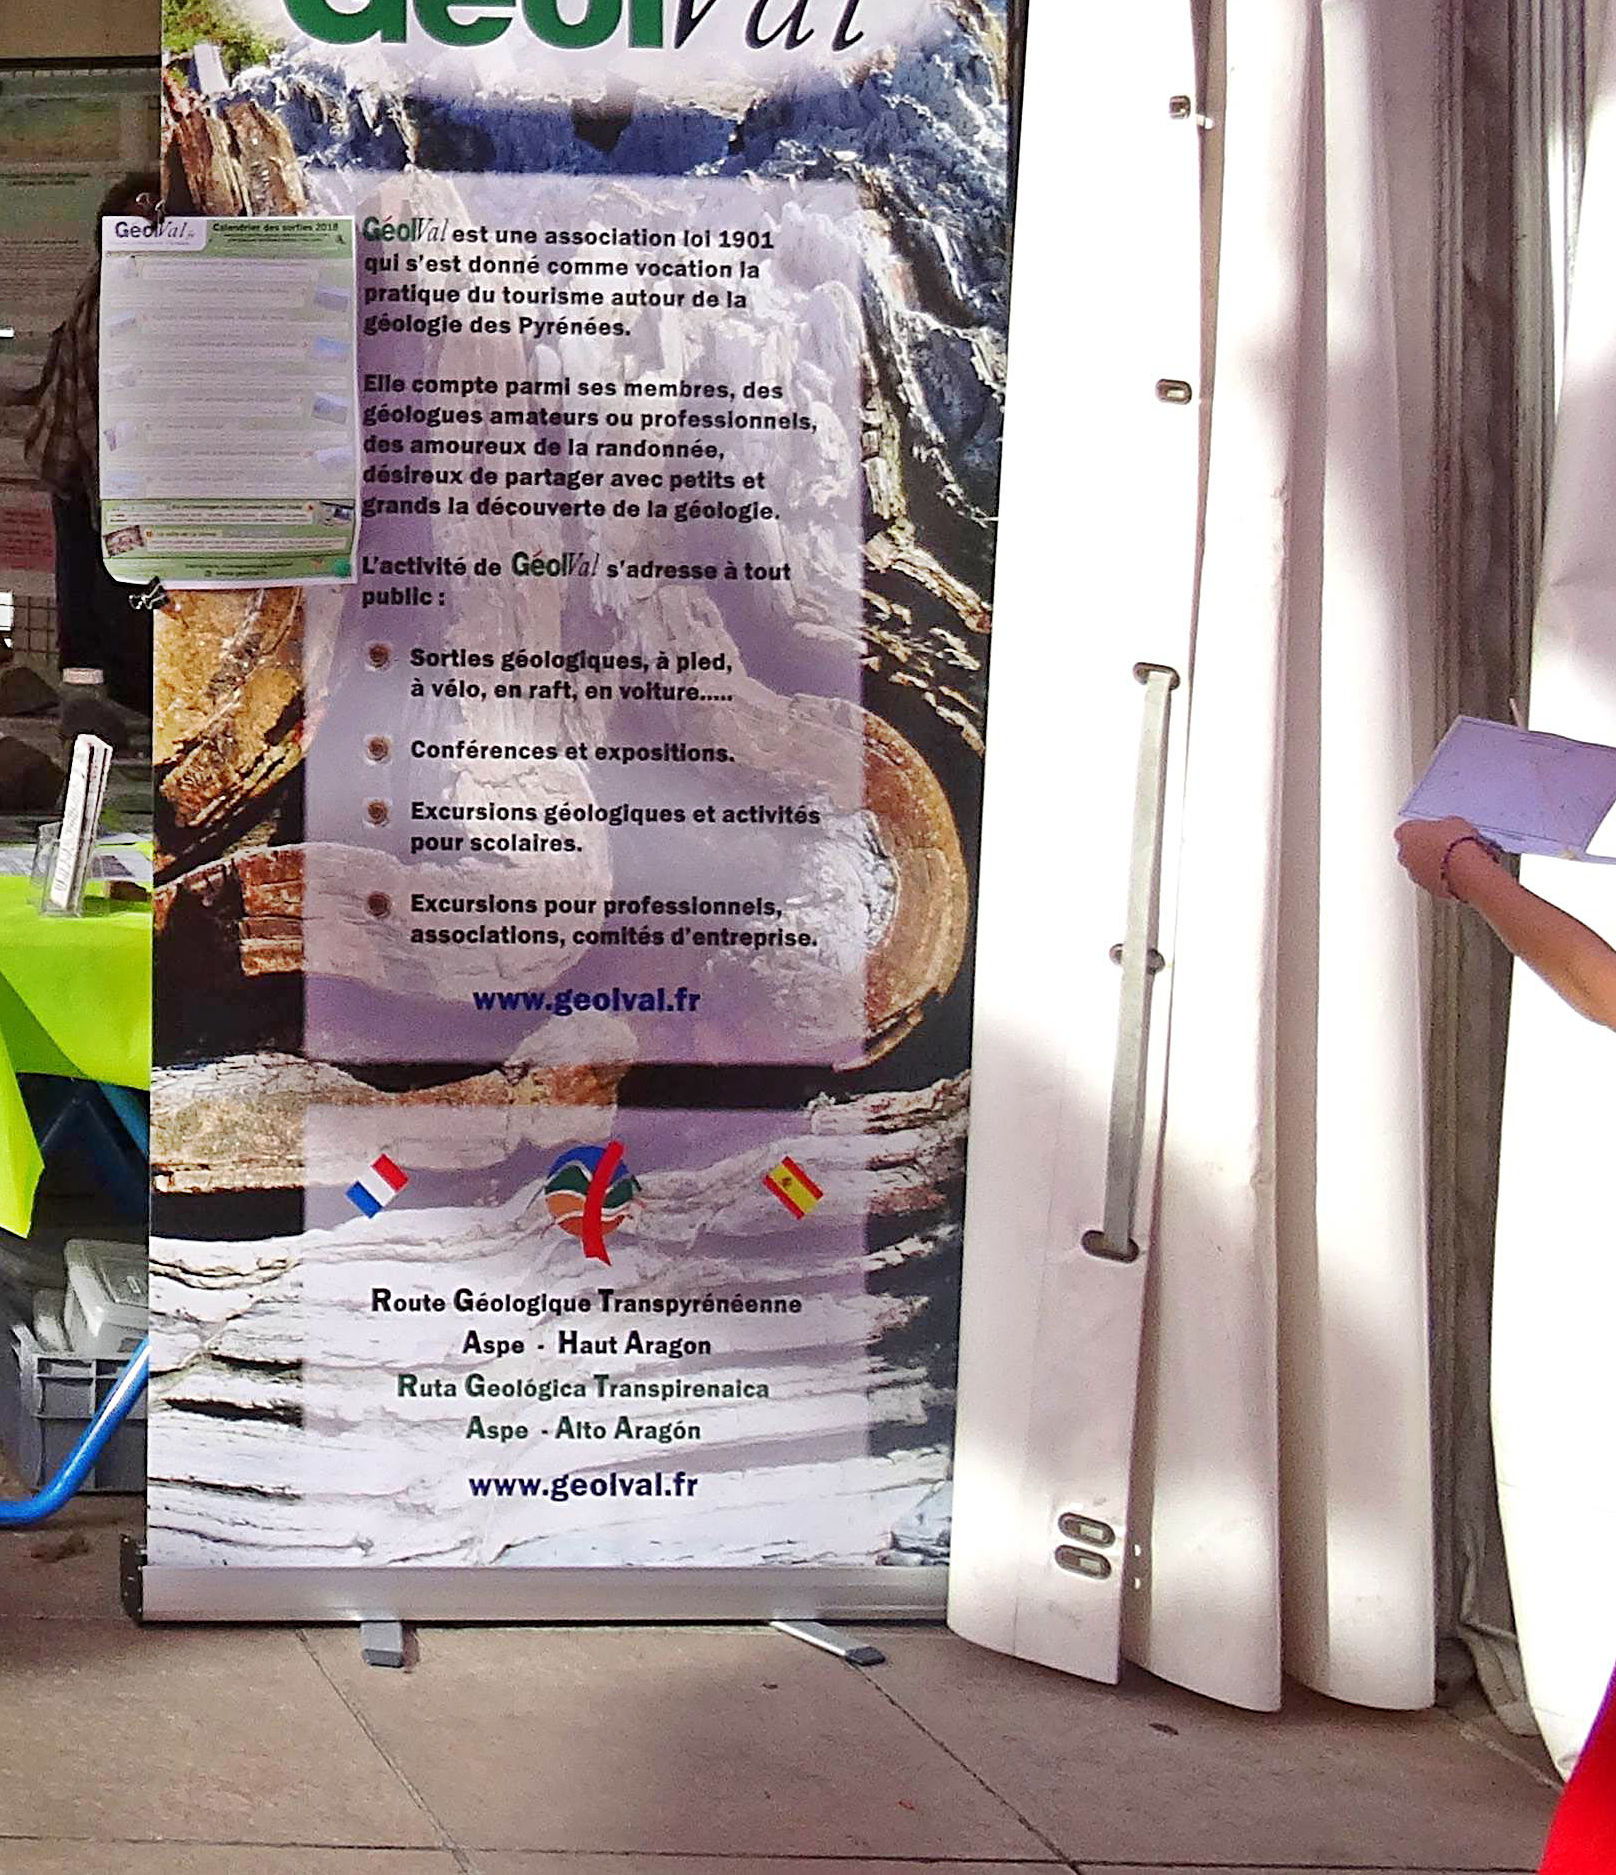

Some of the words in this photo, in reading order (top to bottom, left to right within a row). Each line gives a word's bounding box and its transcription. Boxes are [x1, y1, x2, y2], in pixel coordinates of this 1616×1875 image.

[363, 216, 446, 242] GéolVal
[453, 226, 488, 243] est
[496, 229, 537, 244] une
[545, 228, 676, 247] association
[683, 229, 714, 248] loi
[719, 231, 774, 249] 1901
[366, 255, 399, 276] qui
[407, 256, 461, 274] s'est
[468, 255, 539, 275] donné
[547, 260, 628, 277] comme
[636, 260, 732, 278] vocation
[740, 261, 759, 279] la
[366, 285, 459, 307] pratique
[468, 286, 495, 305] du
[503, 287, 603, 306] tourisme
[611, 289, 685, 307] autour
[692, 291, 719, 308] de
[727, 291, 746, 309] la
[365, 313, 462, 336] géologie
[470, 316, 510, 334] des
[519, 316, 630, 338] Pyrénées.
[365, 375, 405, 394] Elle
[412, 378, 497, 397] compte
[506, 378, 570, 398] parmi
[578, 382, 616, 397] ses
[624, 380, 735, 400] membres,
[743, 382, 782, 399] des
[365, 405, 482, 427] géologues
[490, 409, 598, 427] amateurs
[606, 411, 633, 427] ou
[641, 409, 818, 433] professionnels,
[365, 435, 403, 454] des
[411, 437, 526, 456] amoureux
[534, 439, 561, 456] de
[568, 439, 588, 457] la
[596, 440, 724, 460] randonnée,
[363, 465, 463, 485] désireux
[470, 468, 497, 486] de
[505, 470, 603, 491] partager
[612, 473, 662, 489] avec
[670, 471, 734, 493] petits
[742, 473, 765, 489] et
[363, 495, 440, 518] grands
[448, 497, 468, 515] la
[477, 498, 605, 517] découverte
[613, 499, 639, 517] de
[647, 500, 668, 518] la
[675, 501, 780, 523] géologie.
[362, 556, 466, 576] L'activité
[474, 558, 501, 576] de
[511, 547, 599, 577] GéolVal
[607, 560, 716, 580] s'adresse
[723, 560, 738, 580] à
[745, 563, 790, 581] tout
[362, 588, 430, 610] public
[411, 648, 493, 668] Sorties
[501, 649, 649, 673] géologiques,
[656, 650, 668, 670] à
[677, 651, 732, 673] pied,
[411, 678, 424, 698] à
[432, 680, 486, 702] vélo,
[495, 684, 521, 699] en
[529, 681, 577, 703] raft,
[585, 685, 611, 701] en
[411, 739, 557, 760] Conférences
[565, 743, 588, 760] et
[595, 742, 735, 765] expositions.
[411, 802, 536, 822] Excursions
[544, 802, 685, 826] géologiques
[693, 806, 715, 824] et
[723, 804, 820, 825] activités
[411, 835, 463, 854] pour
[471, 833, 582, 853] scolaires.
[411, 894, 536, 914] Excursions
[544, 897, 595, 917] pour
[603, 895, 782, 918] professionnels,
[411, 925, 565, 948] associations,
[573, 926, 664, 946] comités
[671, 927, 818, 951] d'entreprise.
[474, 987, 700, 1016] www.geolval.fr
[371, 1288, 445, 1313] Route
[453, 1289, 591, 1317] Géologique
[599, 1288, 801, 1317] Transpyrénéenne
[463, 1330, 524, 1357] Aspe
[558, 1331, 617, 1355] Haut
[625, 1331, 711, 1358] Aragon
[398, 1374, 456, 1398] Ruta
[466, 1374, 585, 1403] Geológica
[593, 1374, 768, 1401] Transpirenaica
[467, 1416, 527, 1443] Aspe
[556, 1416, 607, 1440] Alto
[615, 1416, 700, 1443] Aragón
[469, 1472, 698, 1500] www.geolval.fr
